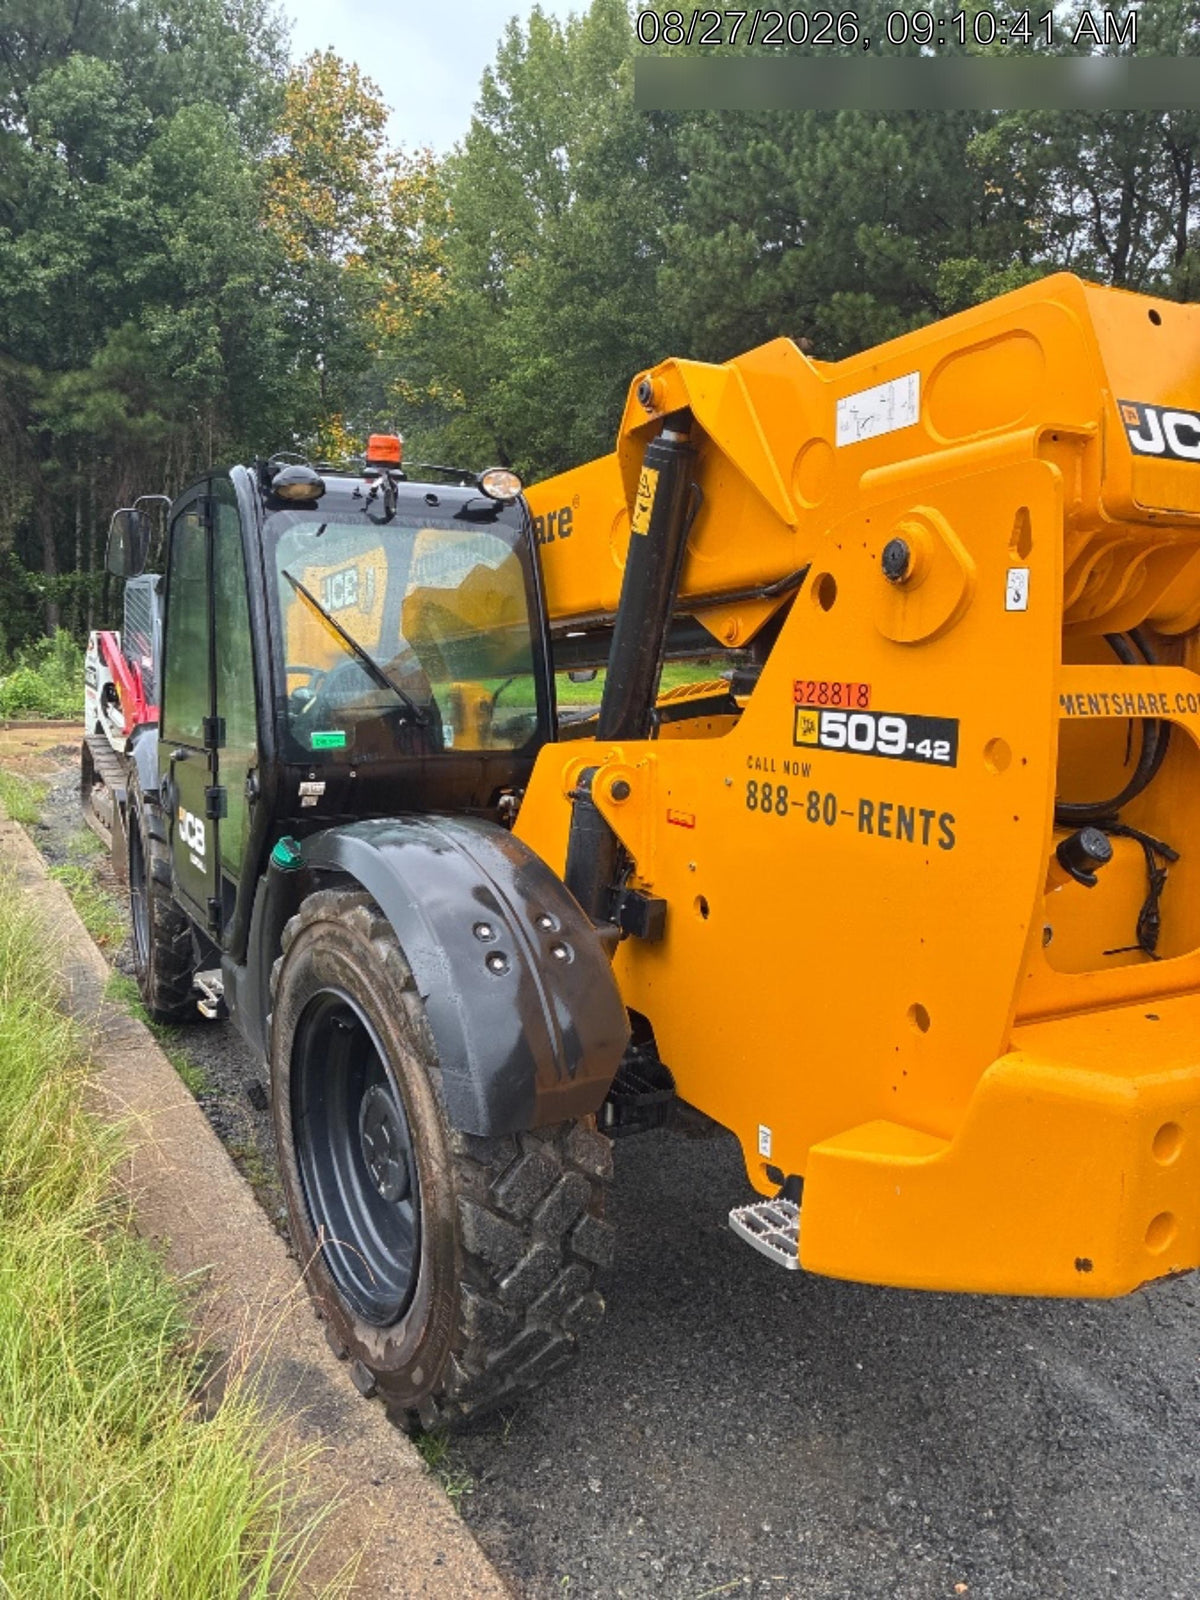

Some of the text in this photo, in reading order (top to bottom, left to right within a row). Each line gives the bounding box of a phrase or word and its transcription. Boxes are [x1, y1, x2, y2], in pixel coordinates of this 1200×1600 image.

[794, 680, 869, 708] 528818
[820, 711, 950, 761] 509-42
[747, 755, 812, 778] CALL NOW
[179, 811, 205, 856] JCB
[746, 780, 955, 850] 888-80-RENTS
